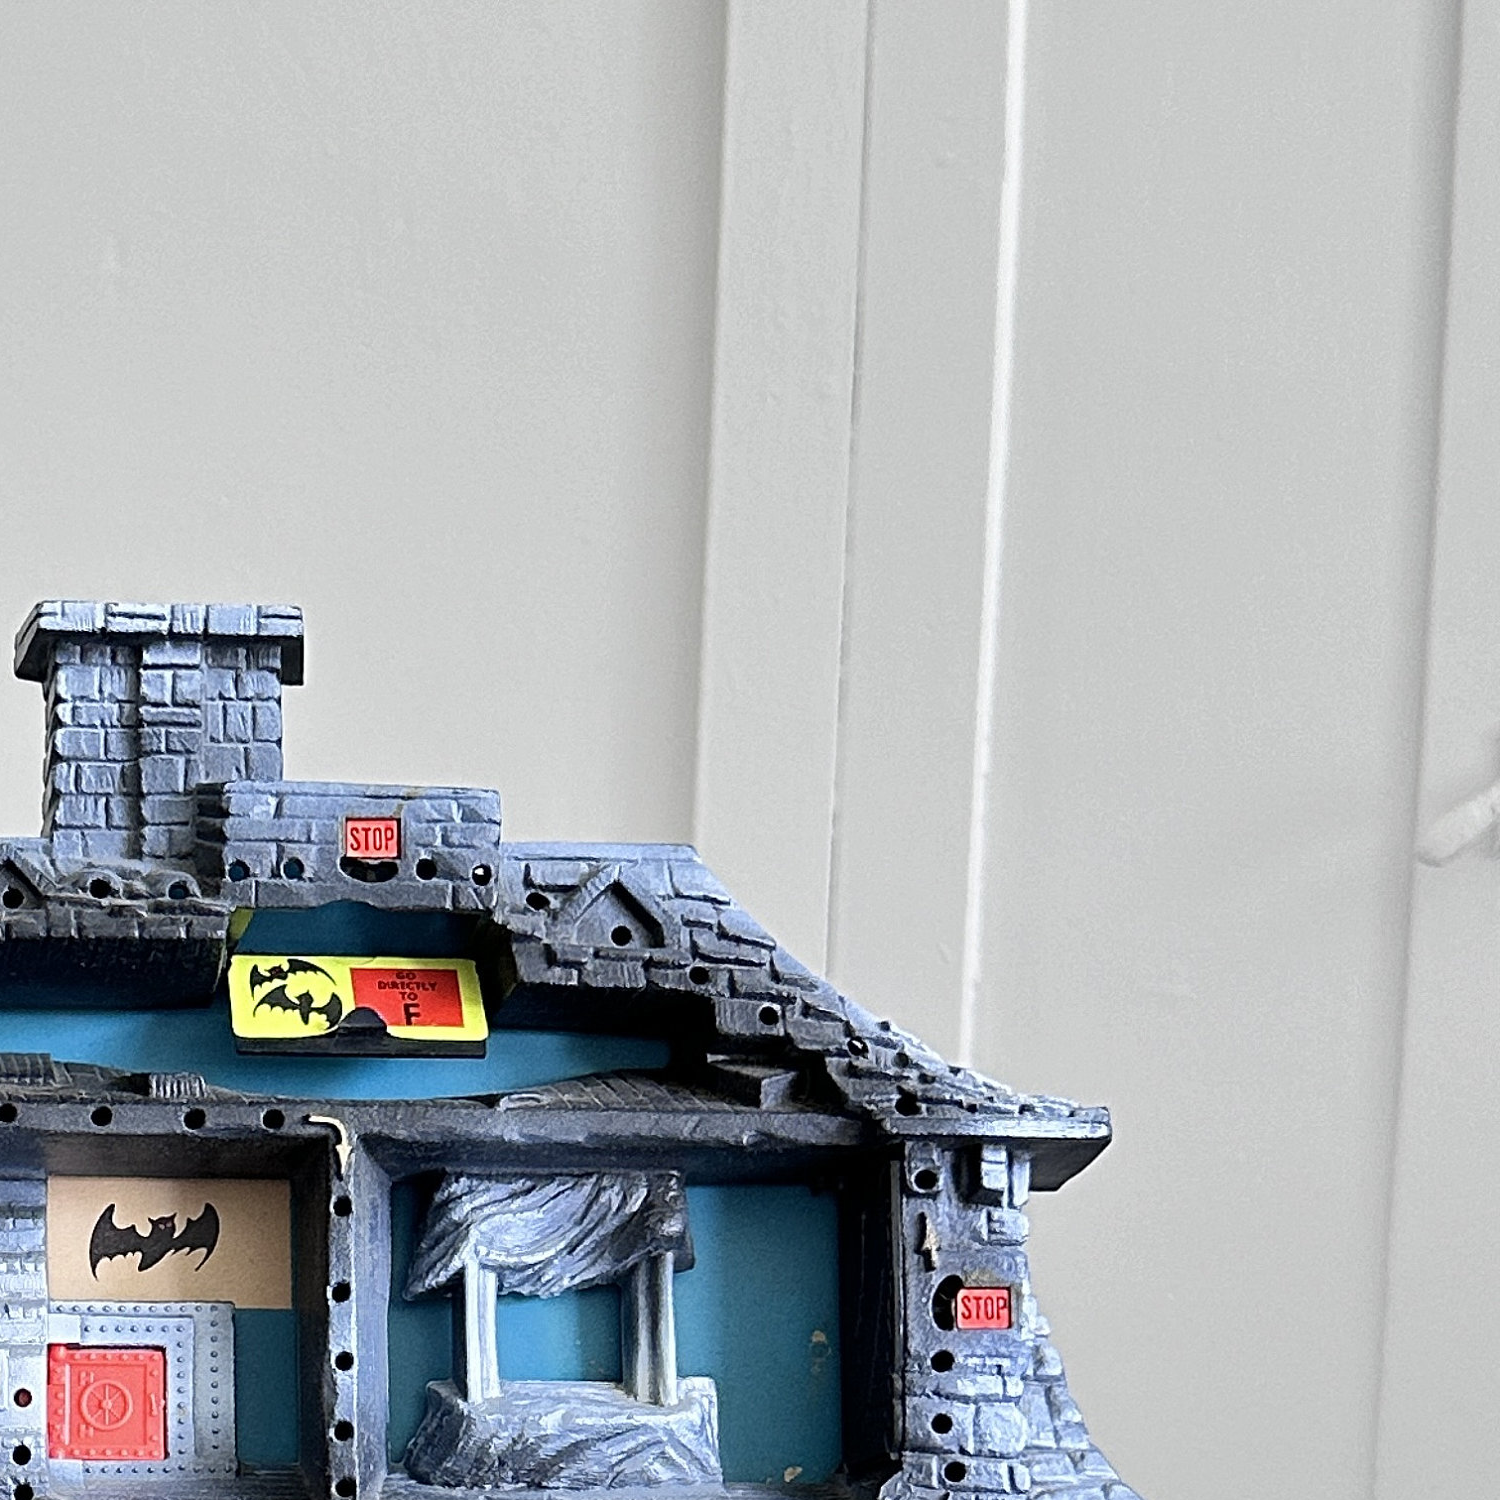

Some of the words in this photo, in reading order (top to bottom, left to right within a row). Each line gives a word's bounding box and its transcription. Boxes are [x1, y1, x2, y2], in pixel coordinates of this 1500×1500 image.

[350, 827, 395, 852] STOP
[395, 971, 417, 981] GO
[378, 981, 437, 991] DIRECTLY
[400, 991, 418, 1001] TO
[403, 1003, 421, 1026] F
[961, 1295, 1007, 1320] STOP
